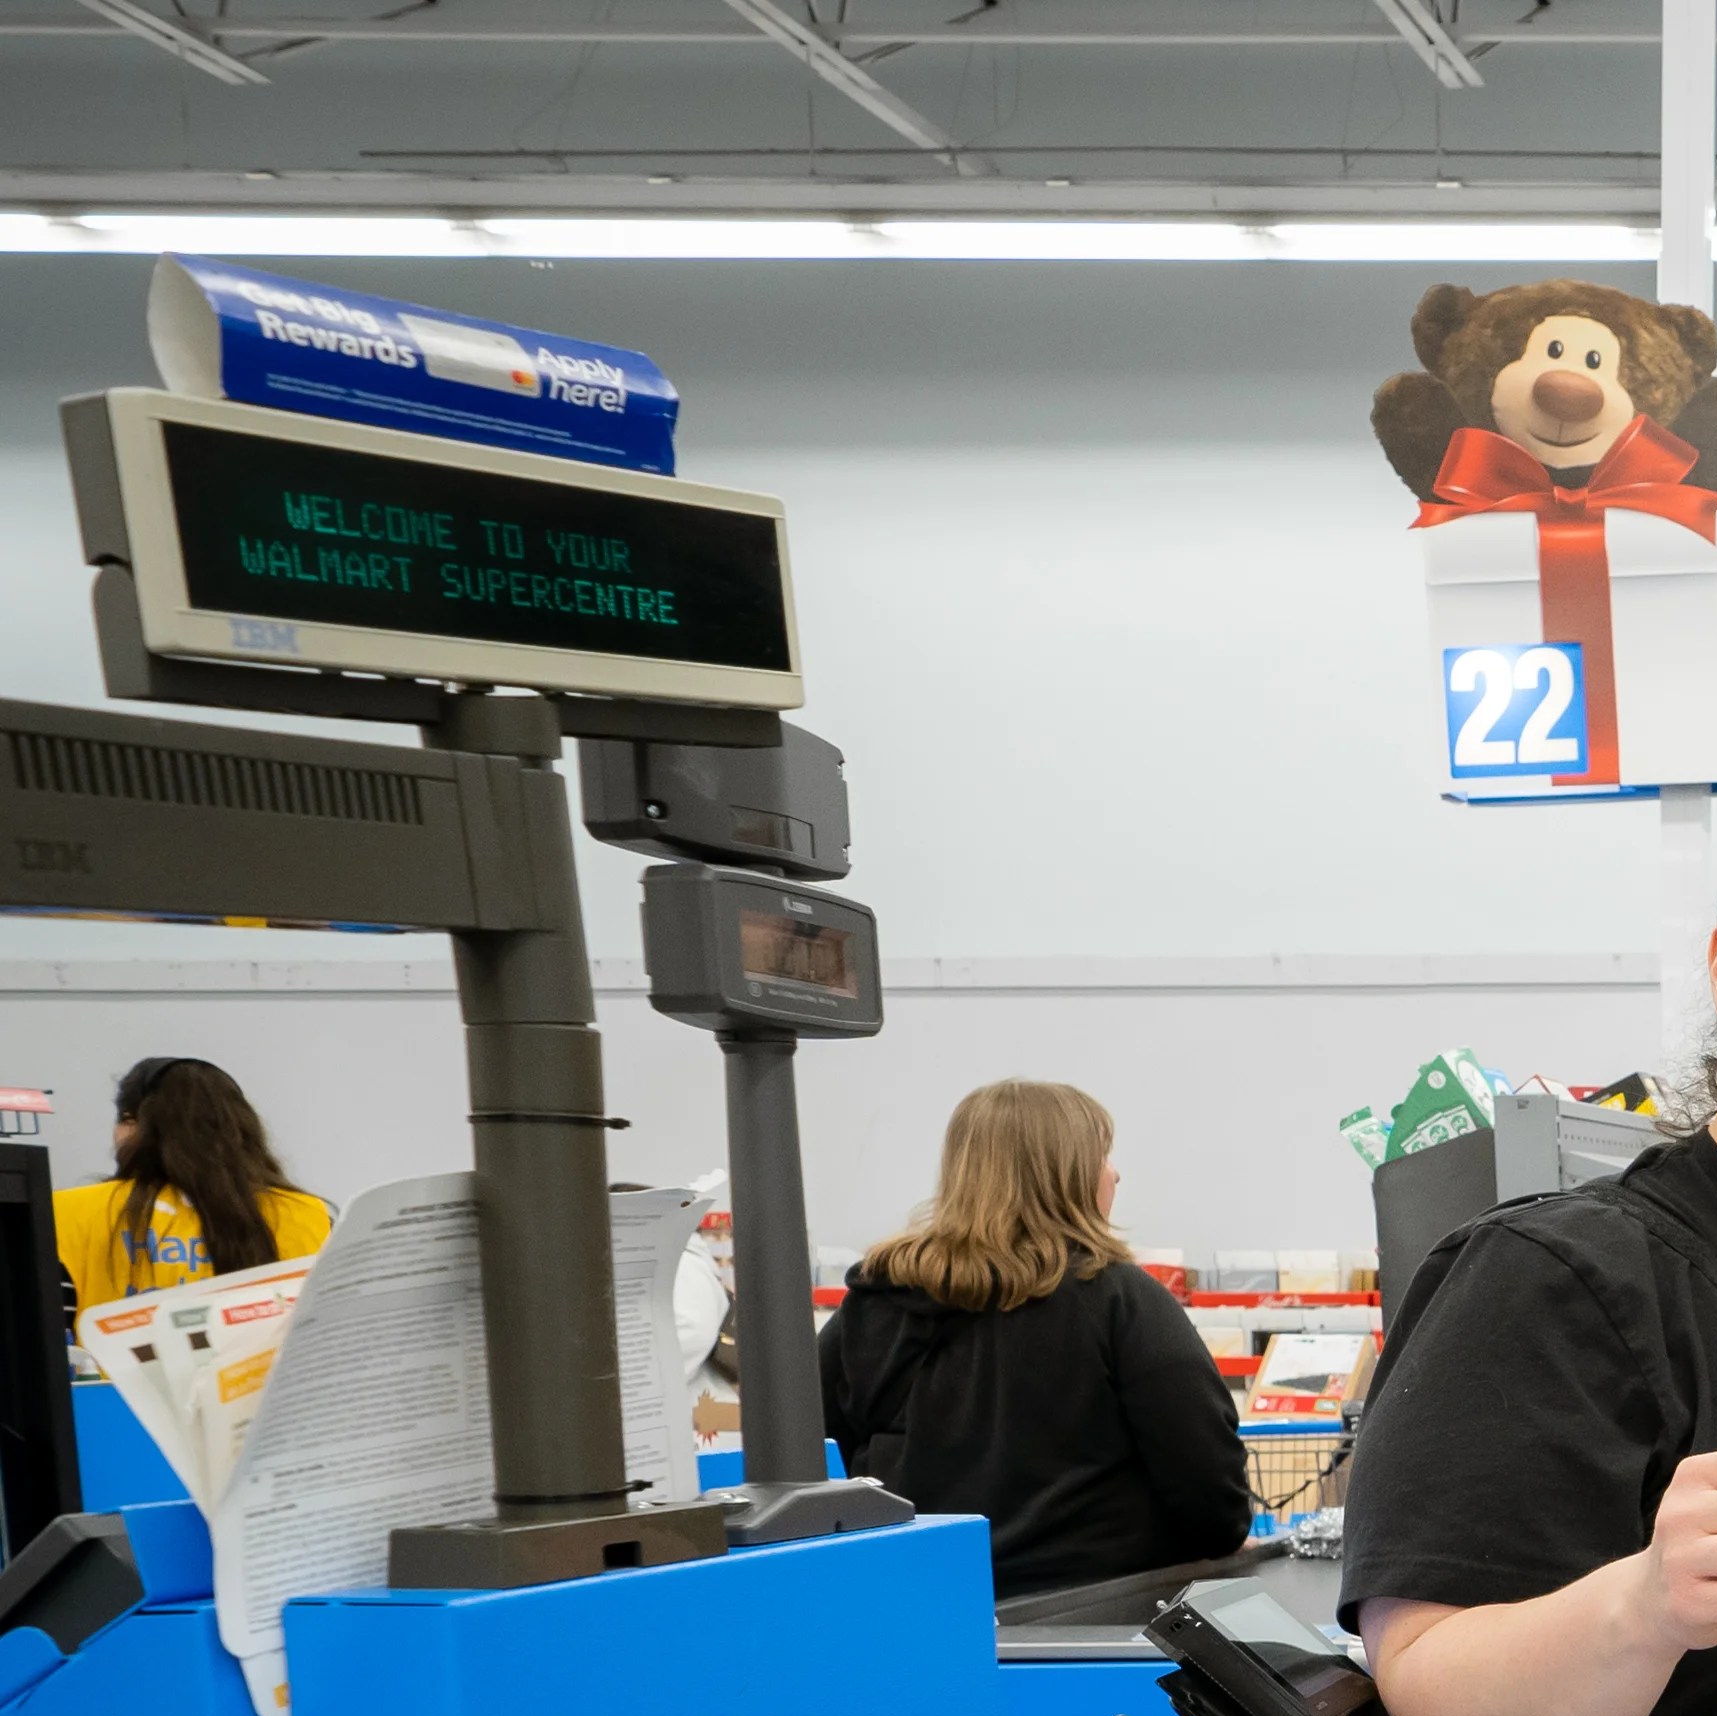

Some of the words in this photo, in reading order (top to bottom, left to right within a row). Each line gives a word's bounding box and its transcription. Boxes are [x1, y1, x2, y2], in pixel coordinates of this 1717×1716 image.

[309, 296, 381, 334] Big
[256, 309, 417, 368] Rewards
[537, 346, 626, 387] Apply
[548, 371, 627, 413] here!
[285, 491, 457, 551] WELCOME
[480, 520, 524, 560] TO
[546, 529, 632, 574] YOUR
[239, 535, 412, 593] WALMART
[441, 563, 679, 625] SUPERCENTRE
[226, 619, 299, 652] IBM
[1450, 647, 1579, 766] 22
[121, 1228, 214, 1272] Hap
